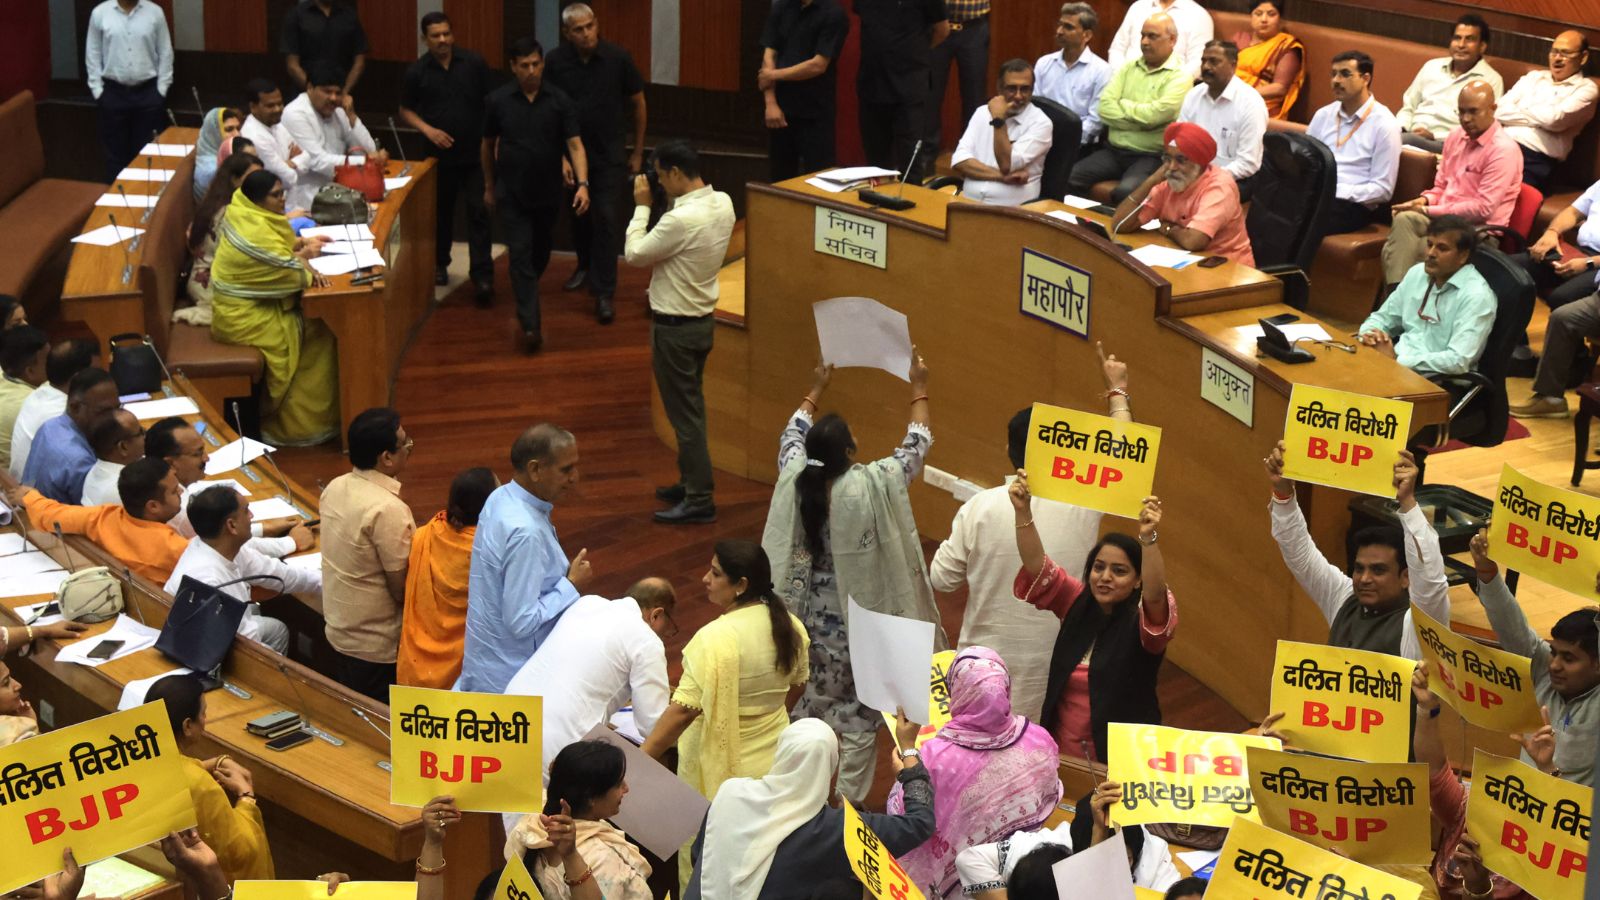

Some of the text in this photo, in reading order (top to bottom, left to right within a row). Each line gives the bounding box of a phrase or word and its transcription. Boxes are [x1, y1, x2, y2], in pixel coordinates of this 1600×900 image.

[828, 211, 875, 239] निगम
[824, 237, 877, 263] सचिव
[1027, 275, 1085, 325] महापौर
[1206, 360, 1251, 405] आयुक्त
[1296, 401, 1398, 440] दलित विरोधी
[1038, 421, 1149, 463] दलित विरोधी
[1307, 436, 1373, 466] BJP
[1051, 456, 1123, 489] BJP
[1500, 485, 1600, 541] दलित विरोध
[1506, 522, 1579, 565] BJP
[1419, 624, 1521, 692] दलित विरोधी
[1283, 659, 1402, 702] दलित विरोधी
[1437, 662, 1503, 709] BJP
[400, 704, 530, 743] दलित विरोधी
[1302, 701, 1384, 734] BJP
[69, 724, 160, 781] विरोधी
[420, 751, 502, 783] BJP
[1147, 751, 1243, 776] BJP
[1122, 781, 1256, 814] लित विरोधी
[1260, 767, 1416, 806] दलित विरोधी
[1484, 775, 1548, 823] दलित
[25, 783, 139, 845] BJP
[1289, 808, 1388, 842] BJP
[1501, 820, 1588, 879] BJP
[1234, 848, 1313, 900] दलित
